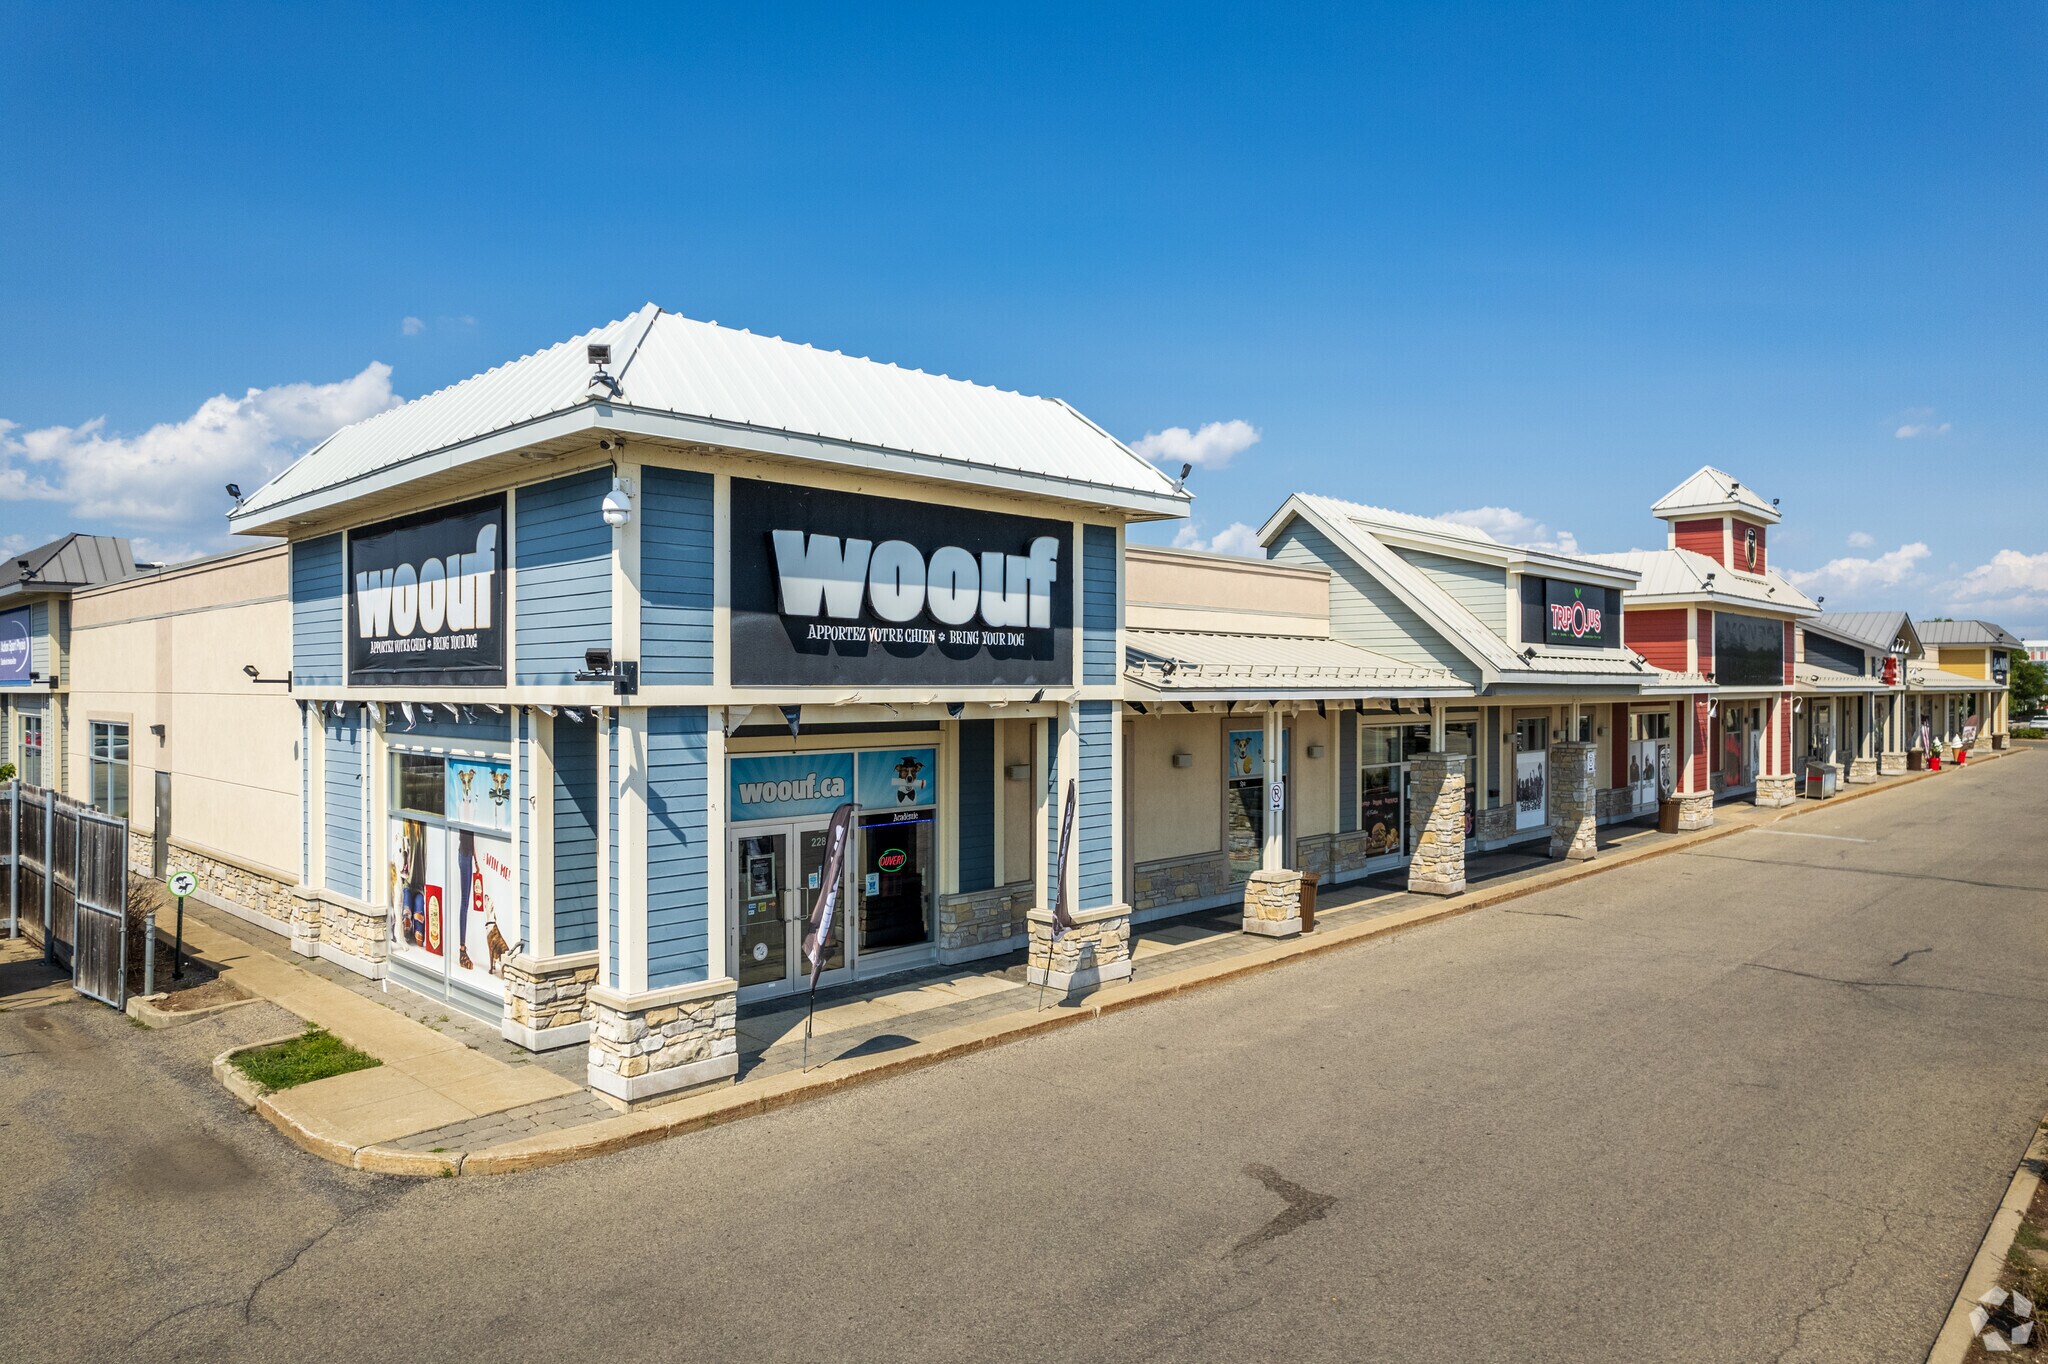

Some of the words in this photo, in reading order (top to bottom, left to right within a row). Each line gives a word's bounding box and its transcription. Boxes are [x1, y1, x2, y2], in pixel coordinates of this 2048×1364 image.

[356, 523, 498, 638] woouf
[769, 529, 1060, 629] woouf
[432, 635, 449, 650] BRING
[450, 634, 465, 649] YOUR
[466, 633, 478, 648] DOG
[807, 624, 866, 640] APPORTEZ
[867, 626, 904, 643] VOTRE
[904, 628, 936, 644] CHIEN
[949, 630, 980, 645] BRING
[981, 631, 1006, 646] YOUR
[1007, 632, 1025, 646] DOG
[739, 772, 845, 804] woouf.ca
[485, 852, 499, 872] WIN
[500, 863, 511, 882] ME!
[880, 854, 905, 867] OUVERT
